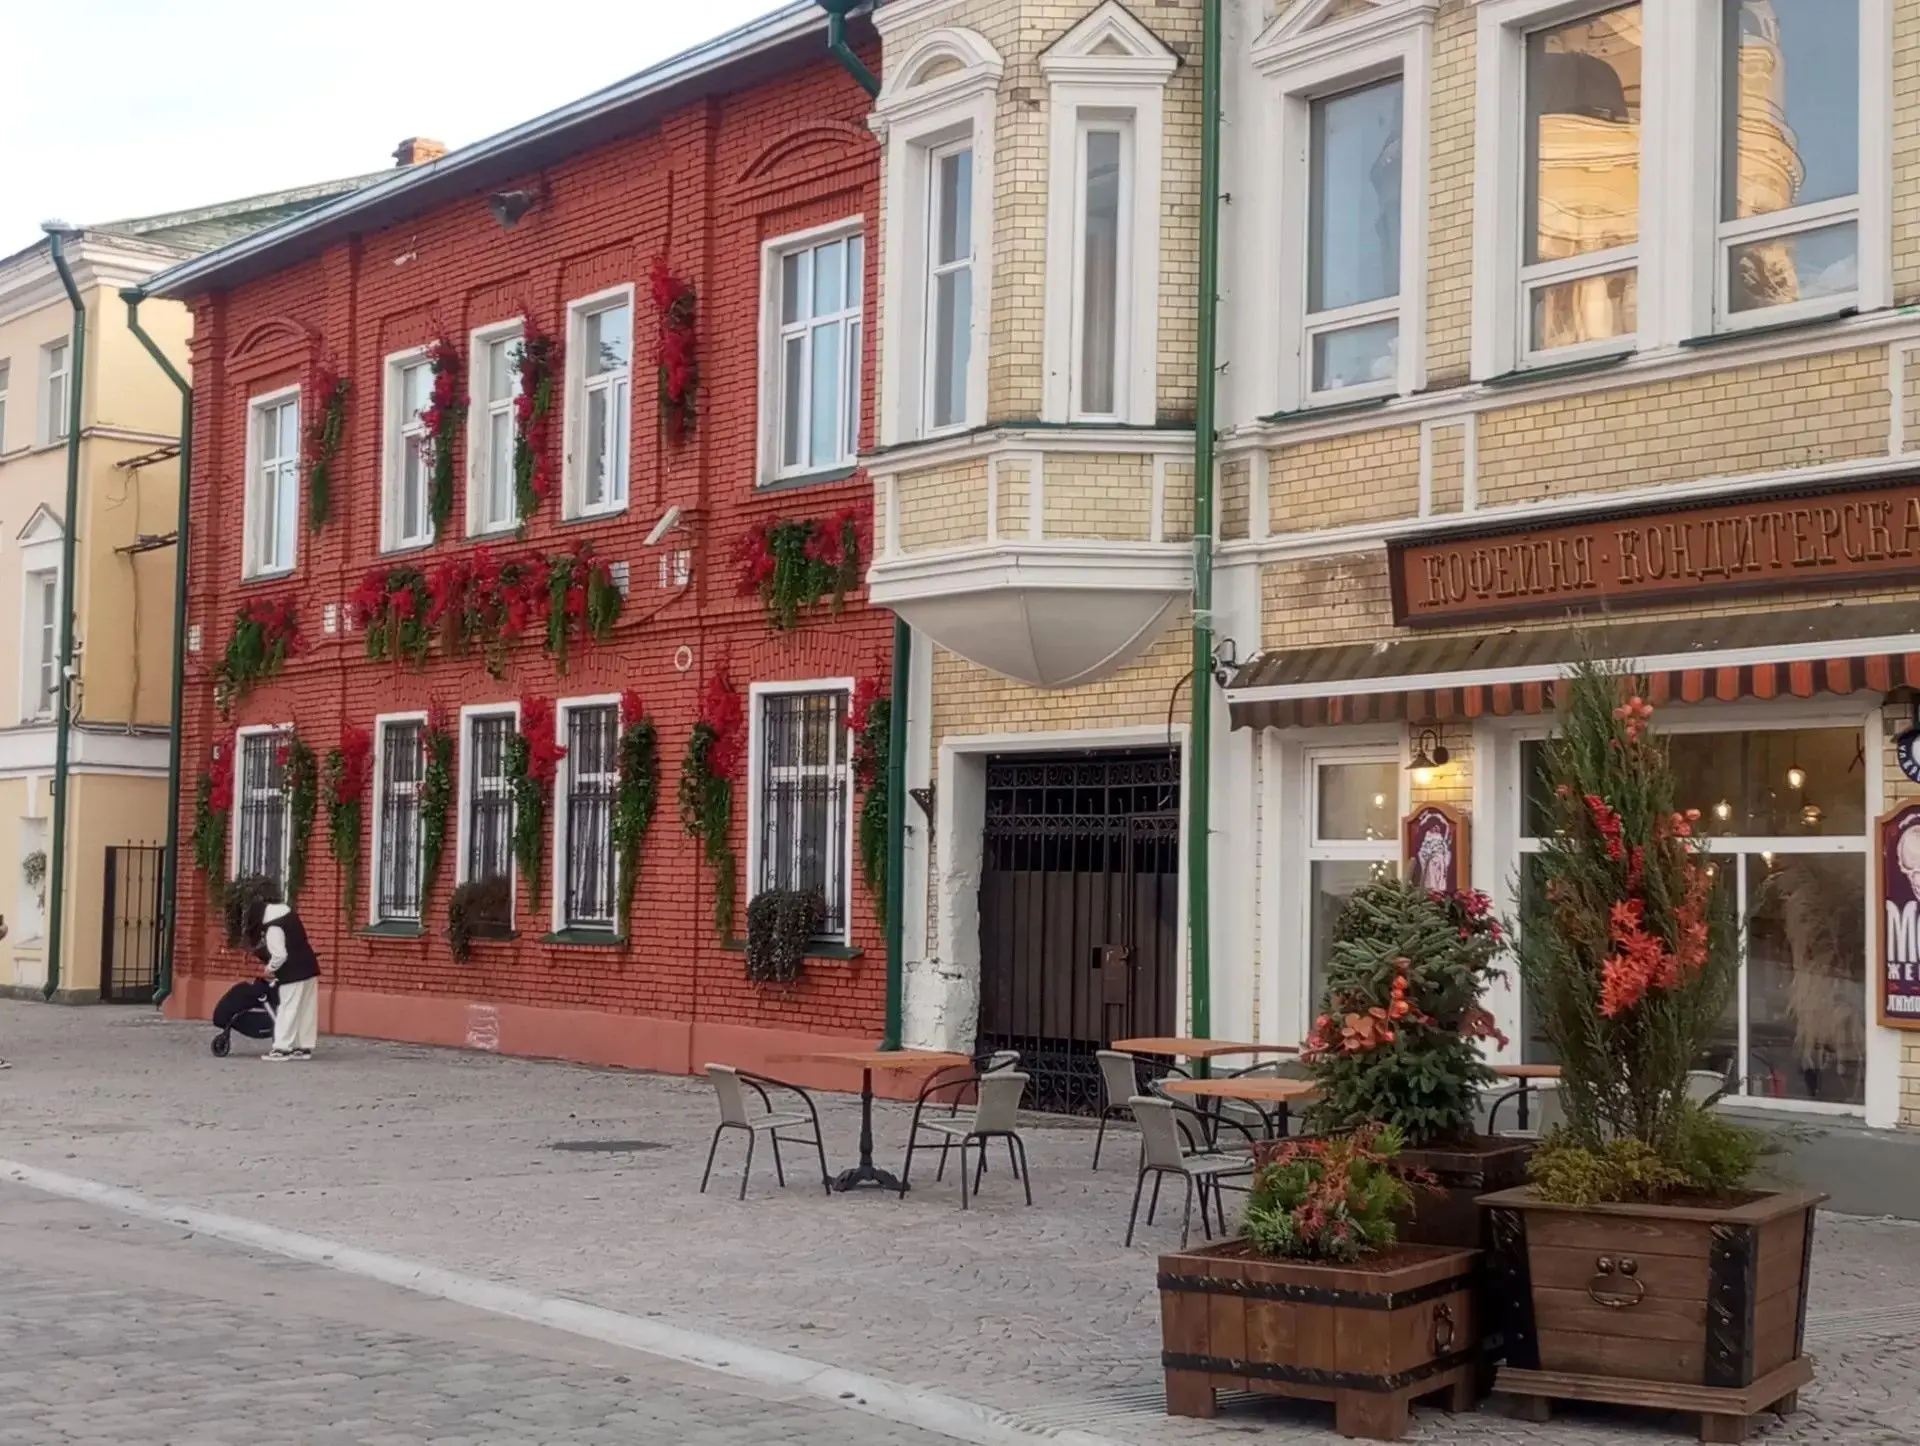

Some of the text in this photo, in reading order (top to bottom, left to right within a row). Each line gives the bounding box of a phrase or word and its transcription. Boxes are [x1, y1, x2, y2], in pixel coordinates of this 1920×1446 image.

[1419, 534, 1597, 607] КОФЕЙНЯ
[1885, 899, 1920, 963] М
[1887, 963, 1920, 981] ЖЕ
